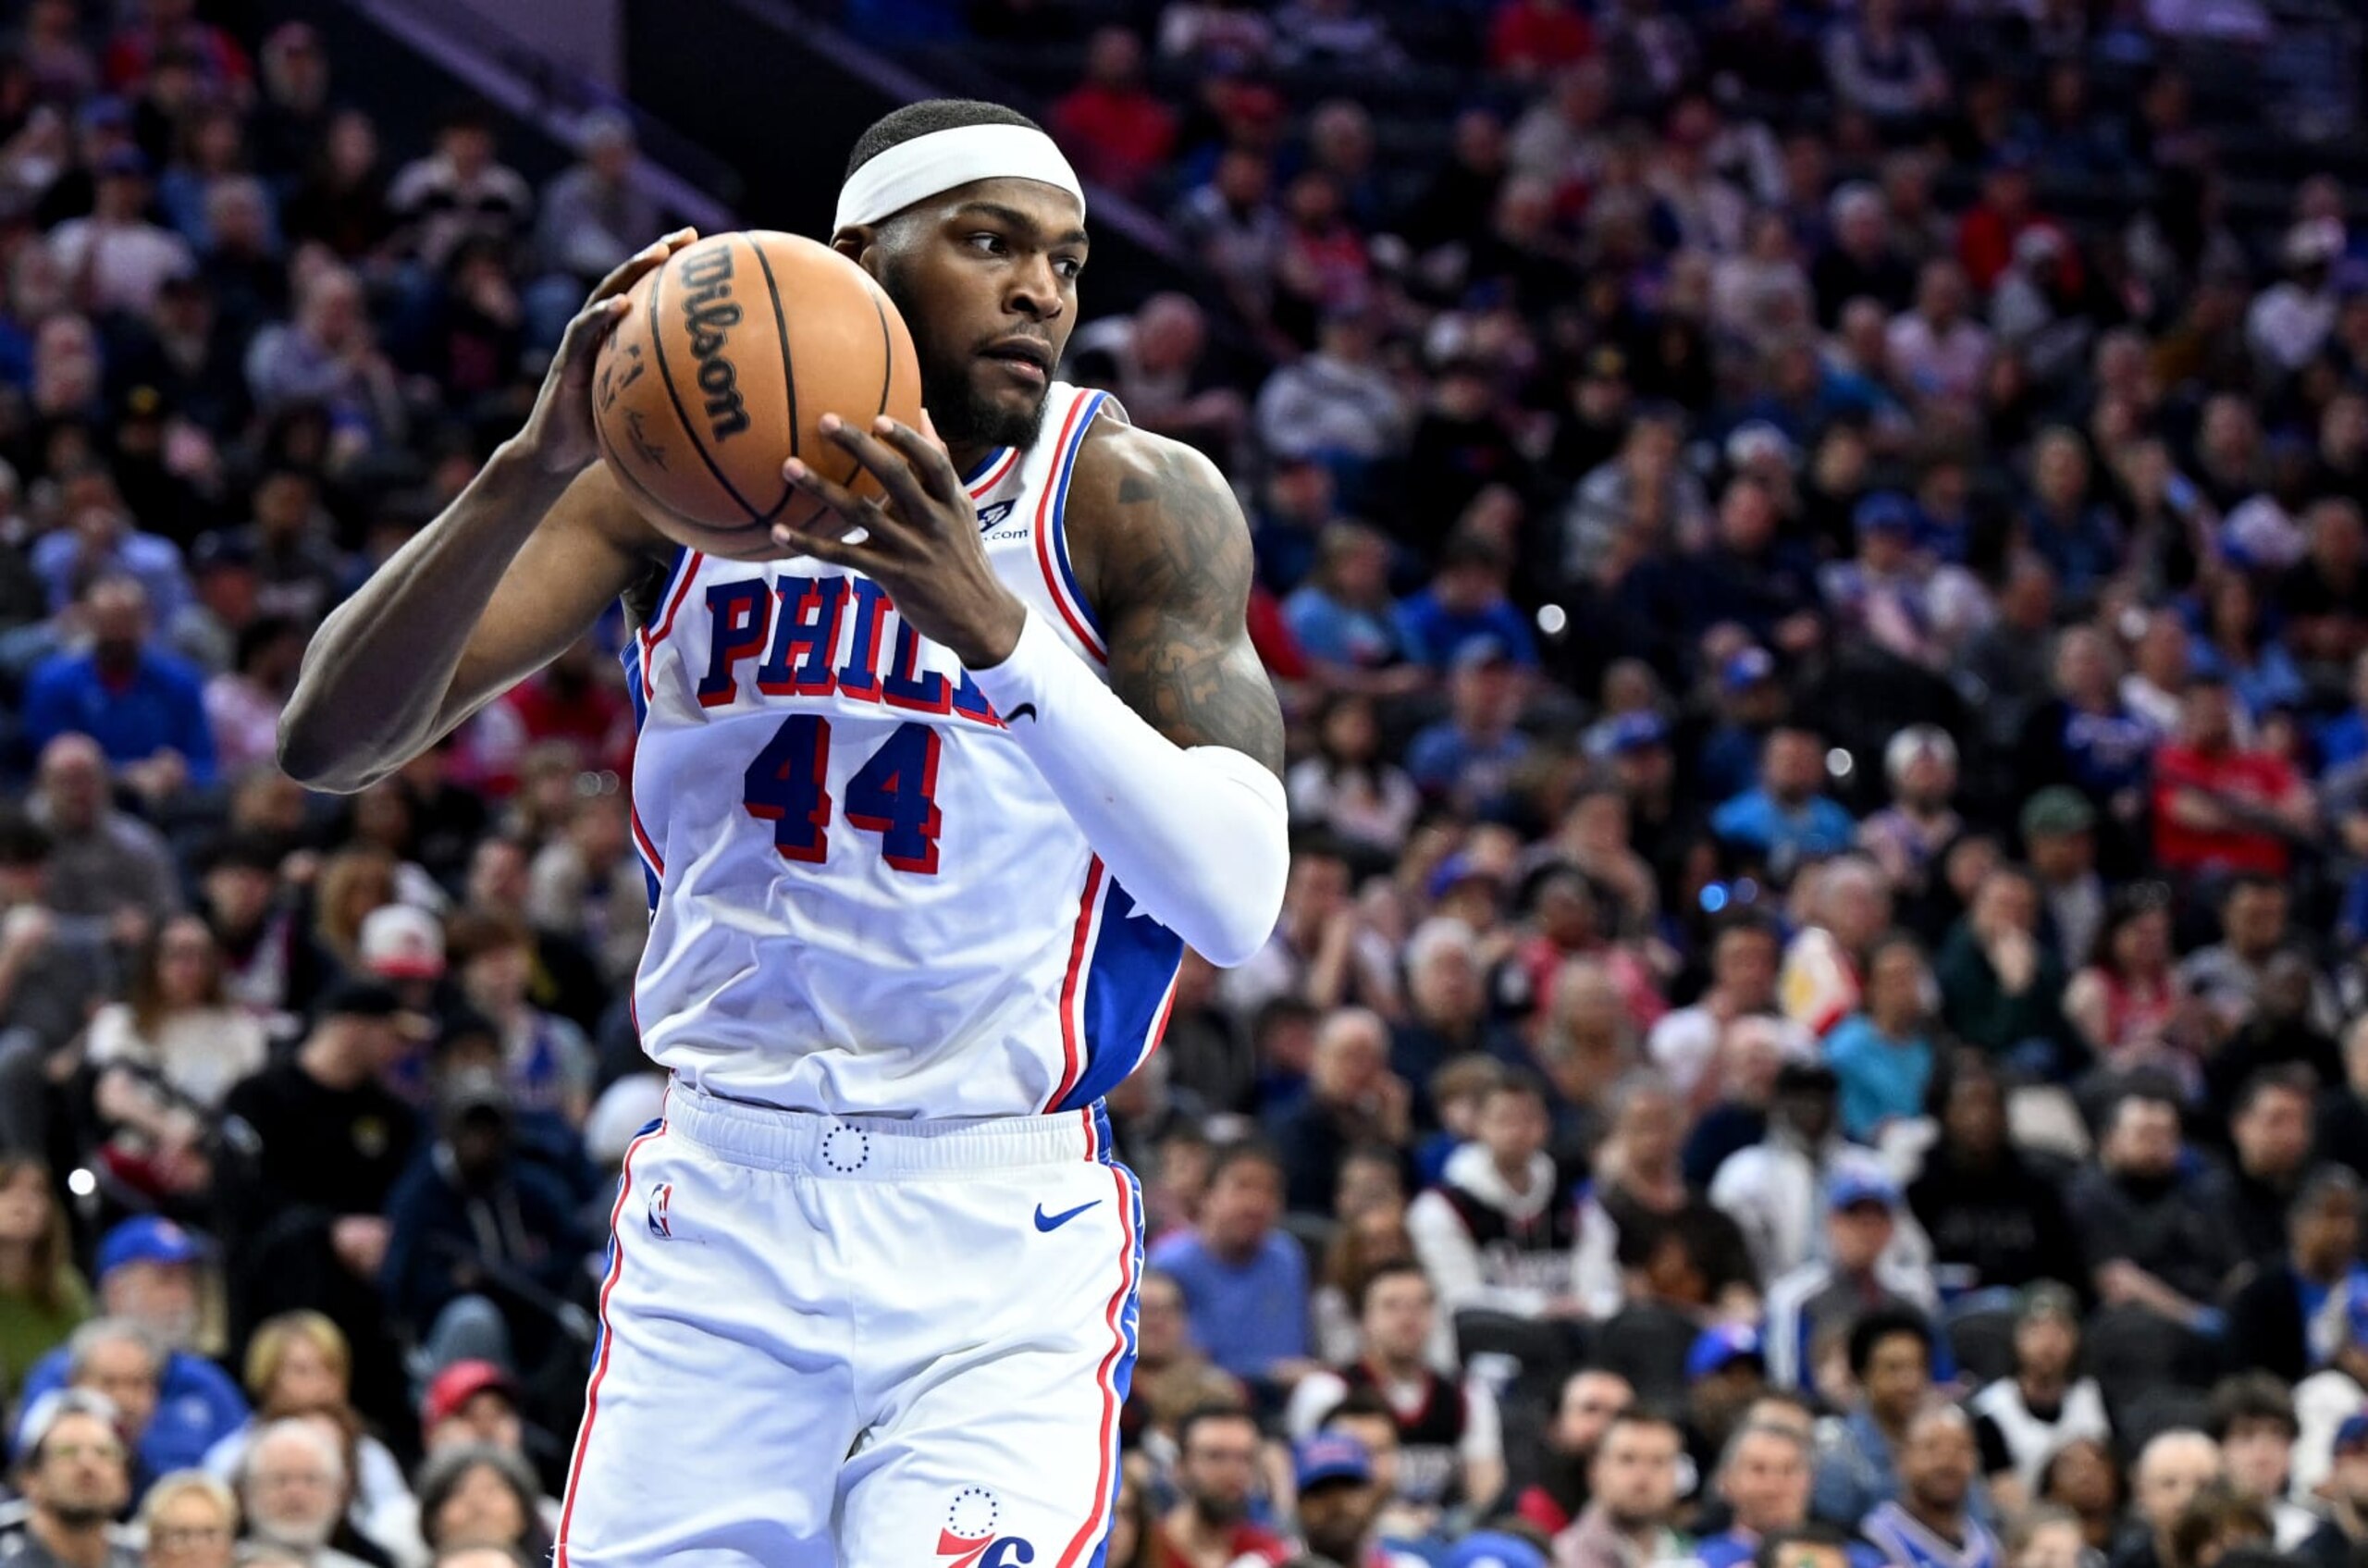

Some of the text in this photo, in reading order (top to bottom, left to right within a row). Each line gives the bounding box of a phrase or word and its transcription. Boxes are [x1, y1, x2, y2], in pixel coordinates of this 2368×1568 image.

[681, 244, 751, 442] Wilson
[697, 575, 1008, 729] PHIL
[744, 714, 942, 874] 44
